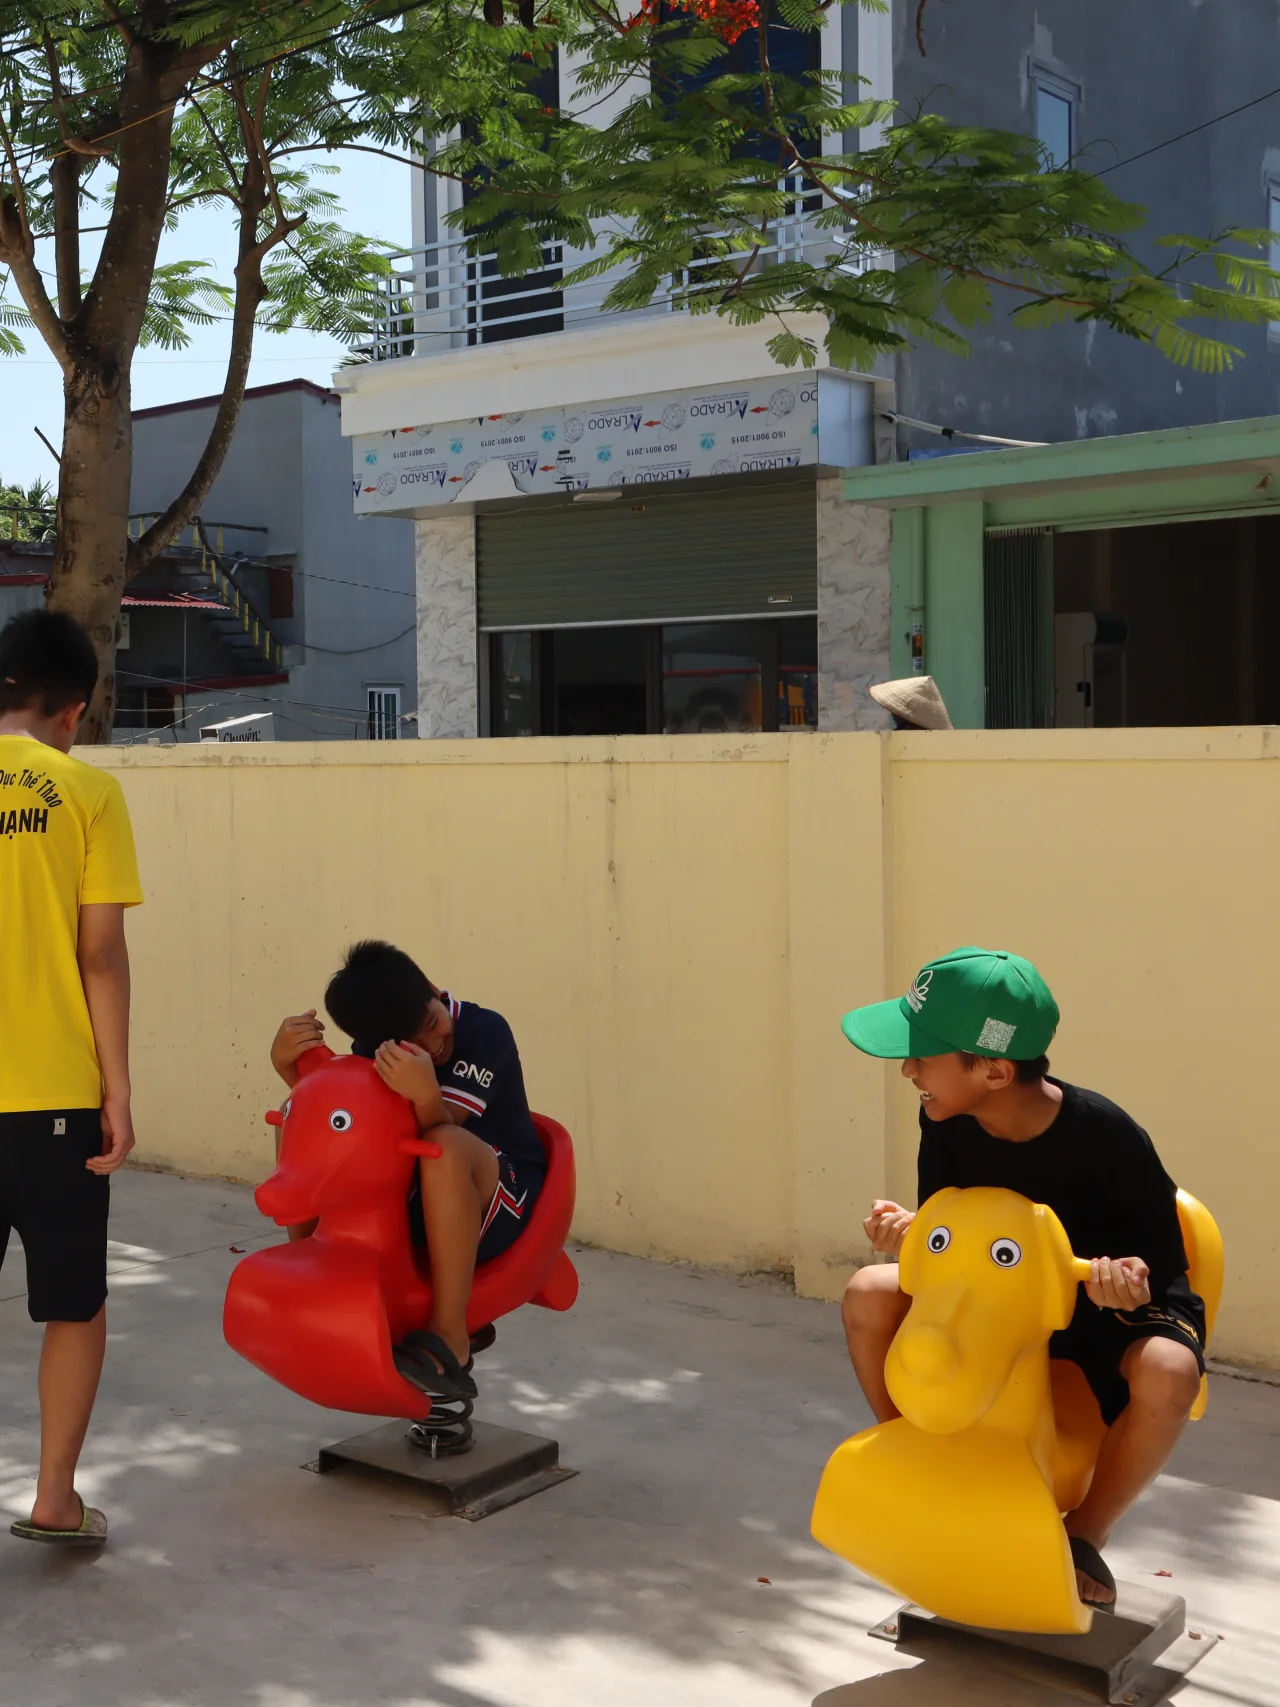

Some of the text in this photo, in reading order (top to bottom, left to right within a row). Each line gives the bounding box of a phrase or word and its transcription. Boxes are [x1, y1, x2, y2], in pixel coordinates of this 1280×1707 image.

[480, 435, 526, 448] ISO 9001:2015
[731, 431, 786, 444] ISO 9001:2015
[424, 447, 436, 455] ISO
[626, 443, 677, 456] ISO 9001:2015
[18, 769, 46, 789] Thể
[36, 778, 63, 808] Thao
[452, 1060, 494, 1089] QNB
